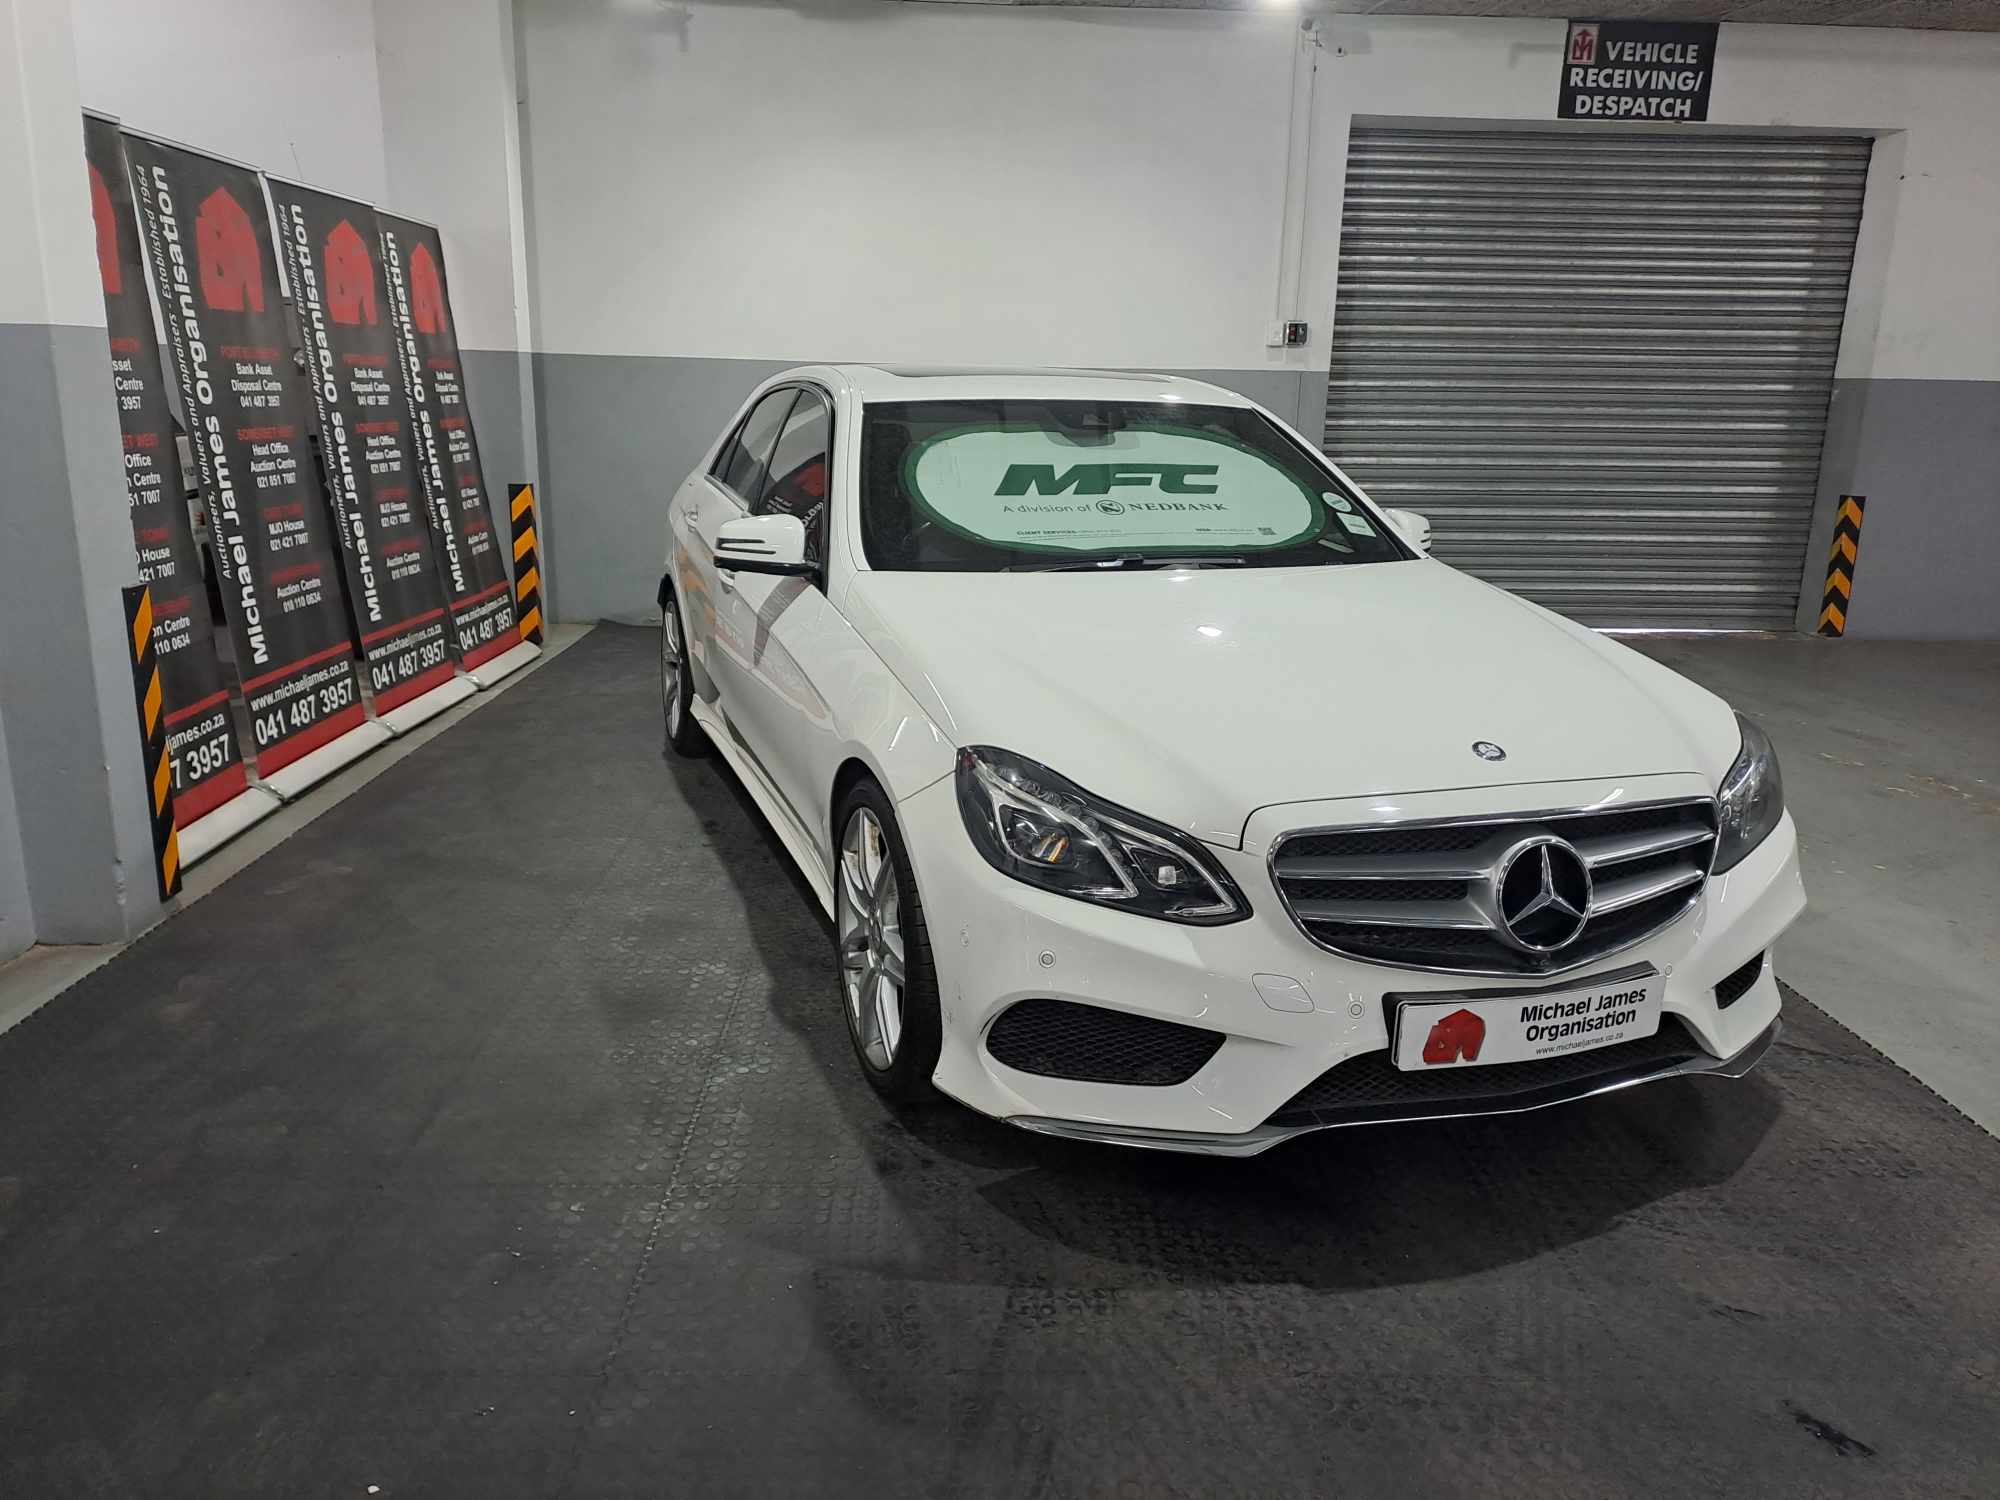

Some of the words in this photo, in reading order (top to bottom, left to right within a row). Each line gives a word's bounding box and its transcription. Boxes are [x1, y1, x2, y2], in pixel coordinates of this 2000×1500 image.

[1605, 41, 1699, 65] VEHICLE
[1569, 67, 1704, 92] RECEIVING/
[1575, 94, 1692, 118] DESPATCH
[135, 164, 152, 204] 1964
[144, 208, 172, 299] Established
[152, 165, 213, 406] Organisation
[290, 204, 337, 403] Organisation
[386, 231, 425, 403] Organisation
[112, 358, 132, 371] sset
[169, 313, 192, 394] Appraisers
[235, 363, 253, 375] Bank
[115, 377, 144, 391] Centre
[231, 380, 262, 394] Disposal
[121, 396, 141, 410] 3957
[184, 396, 199, 427] and
[315, 395, 326, 421] and
[125, 454, 152, 468] Office
[193, 431, 211, 484] Valuers
[270, 443, 289, 455] Office
[322, 423, 336, 470] Valuers
[331, 411, 359, 504] James
[420, 409, 444, 491] James
[133, 472, 161, 487] Centre
[205, 415, 240, 527] James
[251, 460, 276, 473] Auction
[276, 458, 296, 470] Centre
[993, 463, 1219, 496] MFC
[128, 493, 140, 507] 51
[143, 490, 161, 504] 7007
[1003, 504, 1015, 513] A
[1017, 504, 1075, 513] division
[1078, 503, 1092, 513] of
[1129, 502, 1229, 512] NEDBANK
[207, 491, 232, 579] Auctioneers,
[283, 519, 304, 531] House
[142, 547, 170, 562] House
[436, 497, 465, 592] Michael
[139, 567, 154, 582] 421
[157, 562, 175, 578] 7007
[349, 512, 382, 622] Michael
[228, 535, 269, 665] Michael
[277, 584, 300, 599] Auction
[164, 615, 190, 633] Centre
[459, 627, 478, 650] 041
[479, 617, 494, 643] 487
[495, 607, 513, 633] 3957
[154, 641, 170, 656] 110
[172, 633, 190, 649] 0634
[372, 661, 396, 689] 041
[398, 651, 418, 677] 487
[420, 639, 445, 667] 3957
[251, 660, 349, 711] www.michaeljames.co.za
[255, 709, 287, 745] 041
[290, 693, 316, 727] 487
[320, 678, 353, 713] 3957
[165, 712, 225, 754] ljames.co.za
[186, 733, 230, 780] 3957
[1520, 997, 1592, 1023] Michael
[1595, 988, 1647, 1011] James
[1526, 1009, 1637, 1041] Organisation
